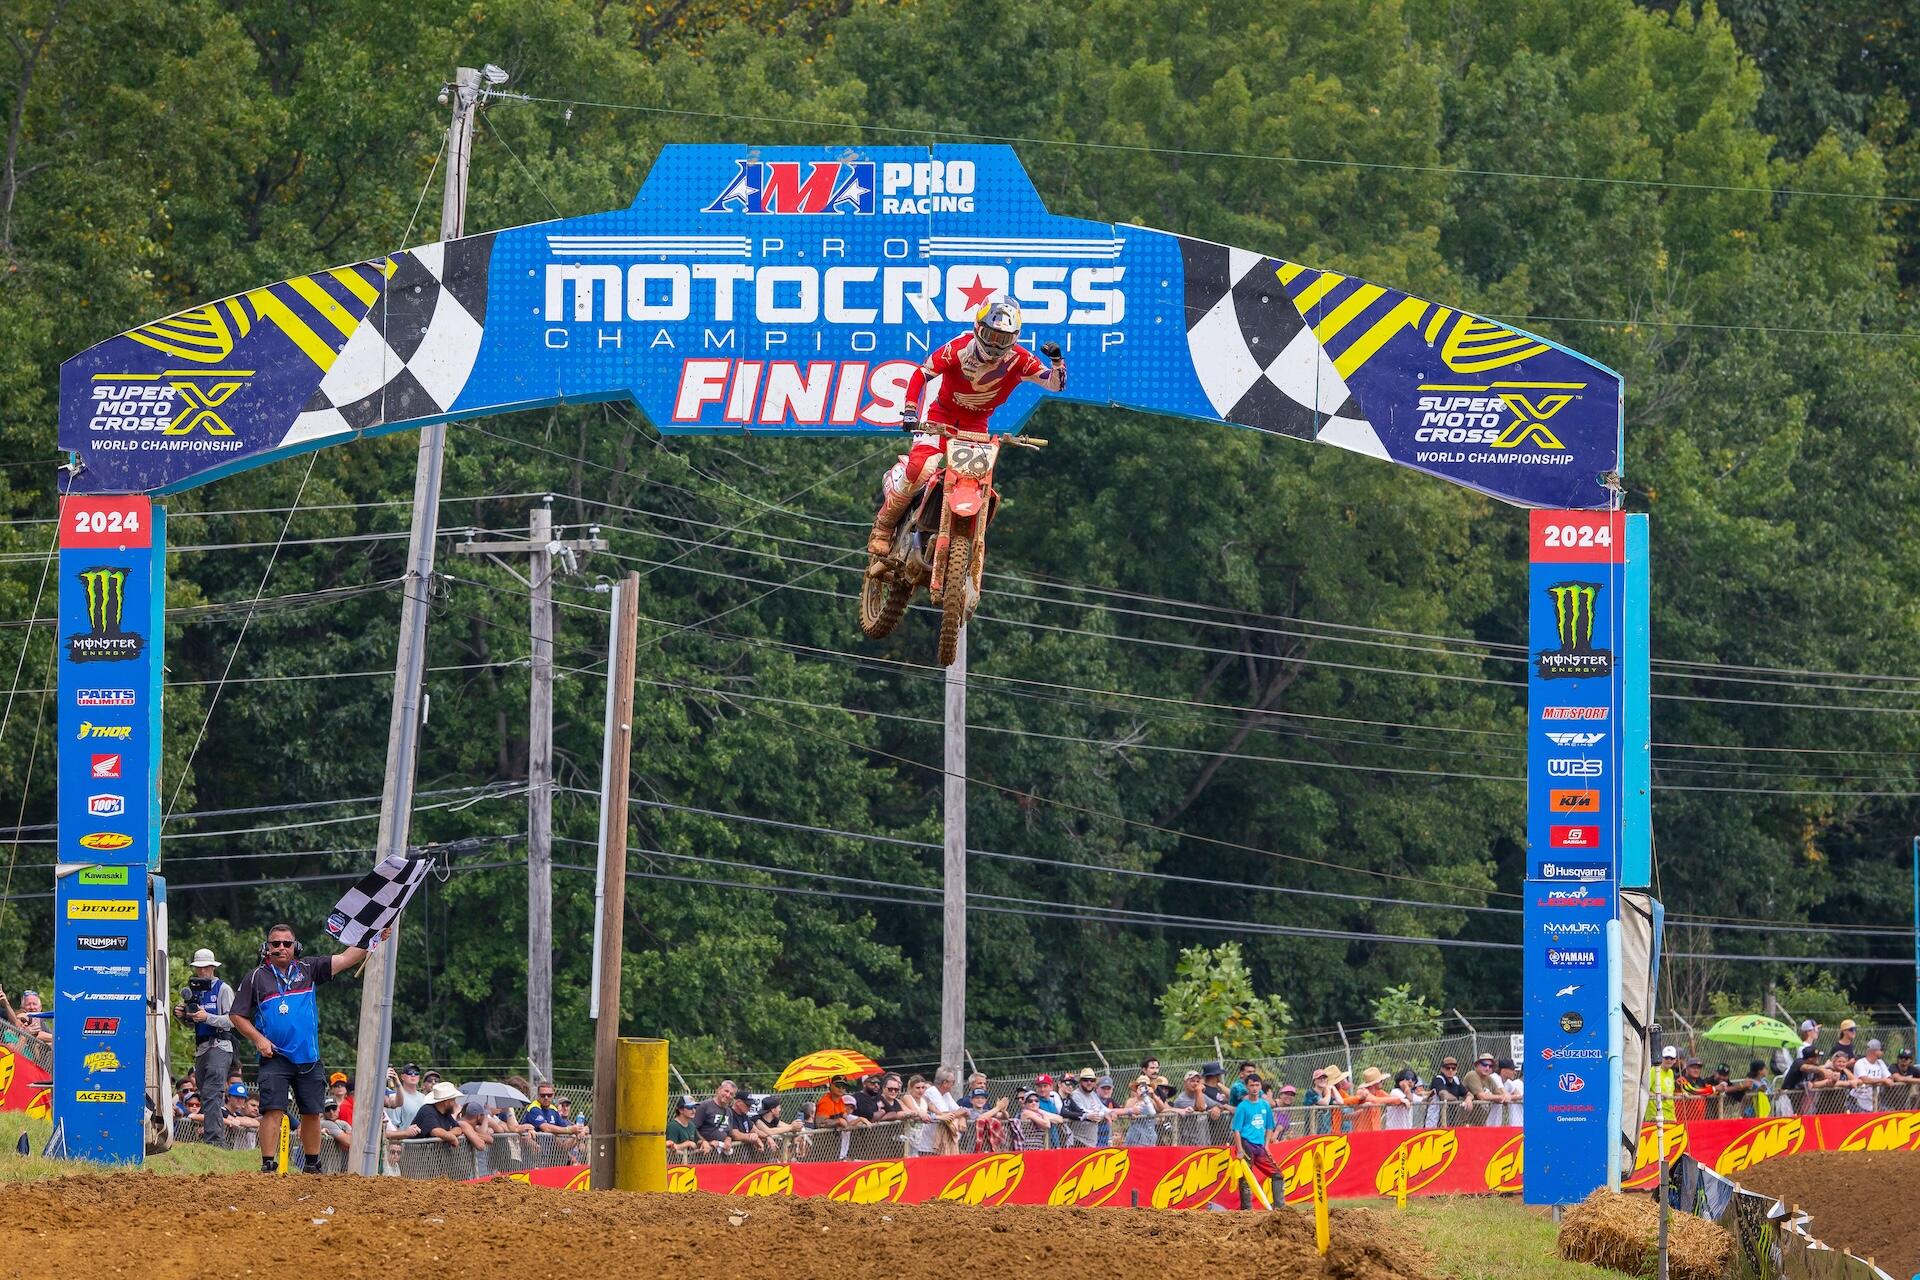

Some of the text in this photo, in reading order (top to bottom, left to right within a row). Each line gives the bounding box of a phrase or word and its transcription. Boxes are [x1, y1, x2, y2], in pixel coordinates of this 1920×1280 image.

[882, 160, 975, 196] PRO
[700, 159, 875, 215] AMA
[882, 196, 974, 215] RACING
[763, 238, 909, 259] PRO
[545, 263, 1125, 325] MOTOCROSS
[544, 328, 1126, 353] CHAMPIONHIP
[91, 385, 175, 400] SUPER
[672, 356, 943, 425] FINIS
[95, 401, 171, 416] MOTO
[1416, 396, 1503, 412] SUPER
[89, 416, 171, 431] CROSS
[1421, 412, 1500, 428] MOTO
[1414, 428, 1501, 444] CROSS
[91, 439, 244, 451] WORLD CHAMPIONSHIP
[952, 448, 990, 474] 96
[1416, 451, 1574, 465] WORLD CHAMPIONSHIP
[75, 511, 139, 533] 2024
[1544, 525, 1611, 547] 2024
[73, 637, 137, 649] MONSTER
[1542, 653, 1608, 667] MONSTER
[78, 690, 134, 699] PARTS
[91, 726, 132, 738] THOR
[1545, 732, 1607, 743] FLY
[1548, 760, 1602, 776] WPS
[92, 799, 120, 812] 100%
[1560, 795, 1591, 806] KTM
[82, 834, 133, 847] FMF
[84, 871, 122, 879] Kawasaki
[1555, 867, 1606, 878] Husqvarna
[1549, 891, 1588, 899] MX-ATV
[81, 904, 135, 912] DUNLOP
[1543, 921, 1600, 931] NAMURA
[78, 937, 117, 947] TRIUMPH
[1560, 952, 1595, 962] YAMAHA
[84, 993, 142, 1001] LANDMASTER
[1555, 1049, 1602, 1058] SUZUKI
[1560, 1073, 1577, 1091] VP
[1633, 1123, 1685, 1172] MF
[1717, 1117, 1802, 1176] FMF
[1380, 1129, 1456, 1195] FMF
[1054, 1149, 1129, 1206] FMF
[1155, 1148, 1231, 1209] FMF
